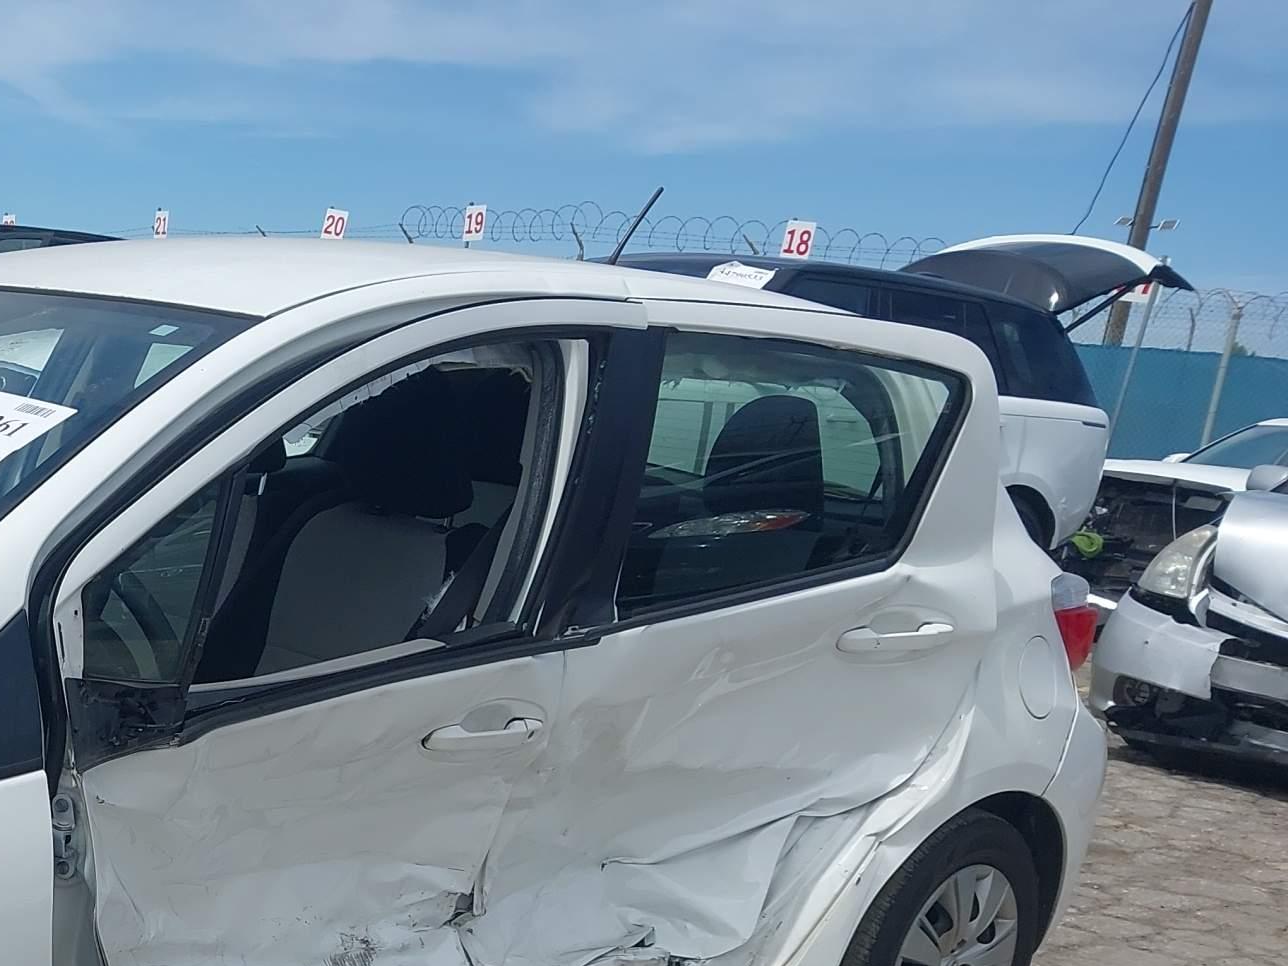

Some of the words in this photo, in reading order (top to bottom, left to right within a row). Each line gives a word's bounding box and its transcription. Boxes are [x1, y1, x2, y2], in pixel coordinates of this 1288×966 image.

[155, 215, 167, 235] 21
[323, 214, 345, 236] 20
[465, 211, 484, 234] 19
[783, 229, 811, 256] 18
